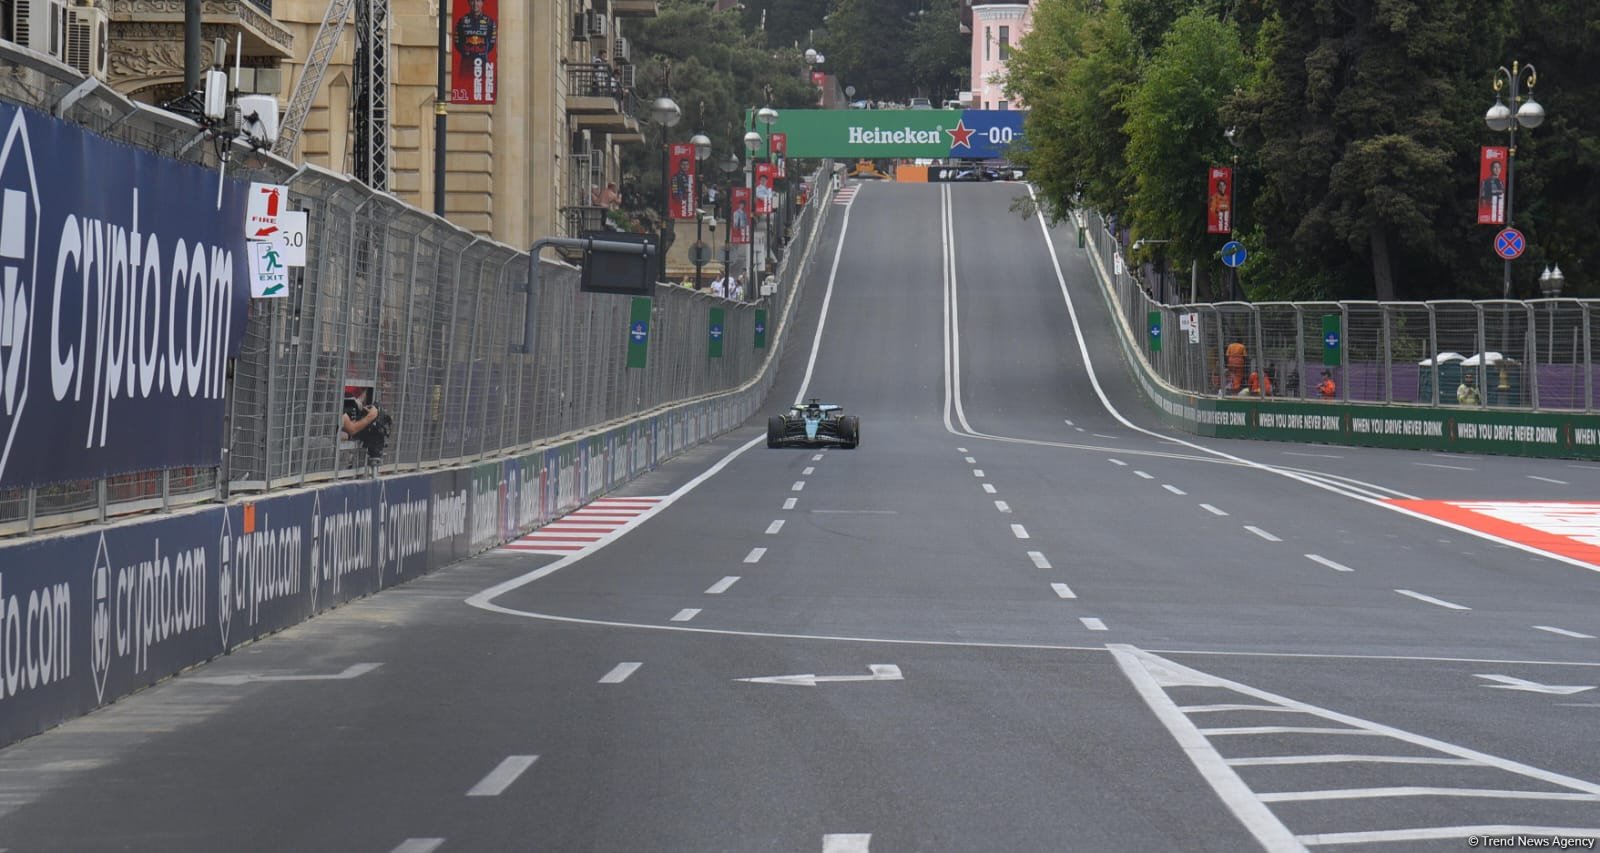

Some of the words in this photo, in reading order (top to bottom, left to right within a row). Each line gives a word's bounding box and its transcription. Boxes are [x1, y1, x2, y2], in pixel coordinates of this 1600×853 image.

[473, 58, 483, 101] SERGIO
[485, 62, 494, 101] PEREZ
[452, 89, 469, 100] 11
[848, 127, 942, 144] Heineken
[252, 216, 277, 224] FIRE
[50, 188, 233, 449] crypto.com
[1259, 413, 1274, 427] WHEN
[1275, 414, 1287, 428] YOU
[1287, 414, 1303, 429] DRIVE
[1304, 415, 1321, 430] NEVER
[1322, 416, 1340, 431] DRINK
[1352, 418, 1370, 433] WHEN
[1371, 419, 1384, 434] YOU
[1384, 419, 1402, 434] DRIVE
[1403, 420, 1422, 436] NEVER
[1423, 421, 1443, 436] DRINK
[1458, 423, 1477, 439] WHEN
[1479, 424, 1493, 440] YOU
[1494, 425, 1513, 441] DRIVE
[1515, 425, 1535, 442] NEVER
[1536, 427, 1558, 443] DRINK
[1575, 428, 1596, 444] WHEN
[323, 497, 372, 595] crypto.com
[235, 512, 301, 626] crypto.com
[116, 538, 206, 674] crypto.com
